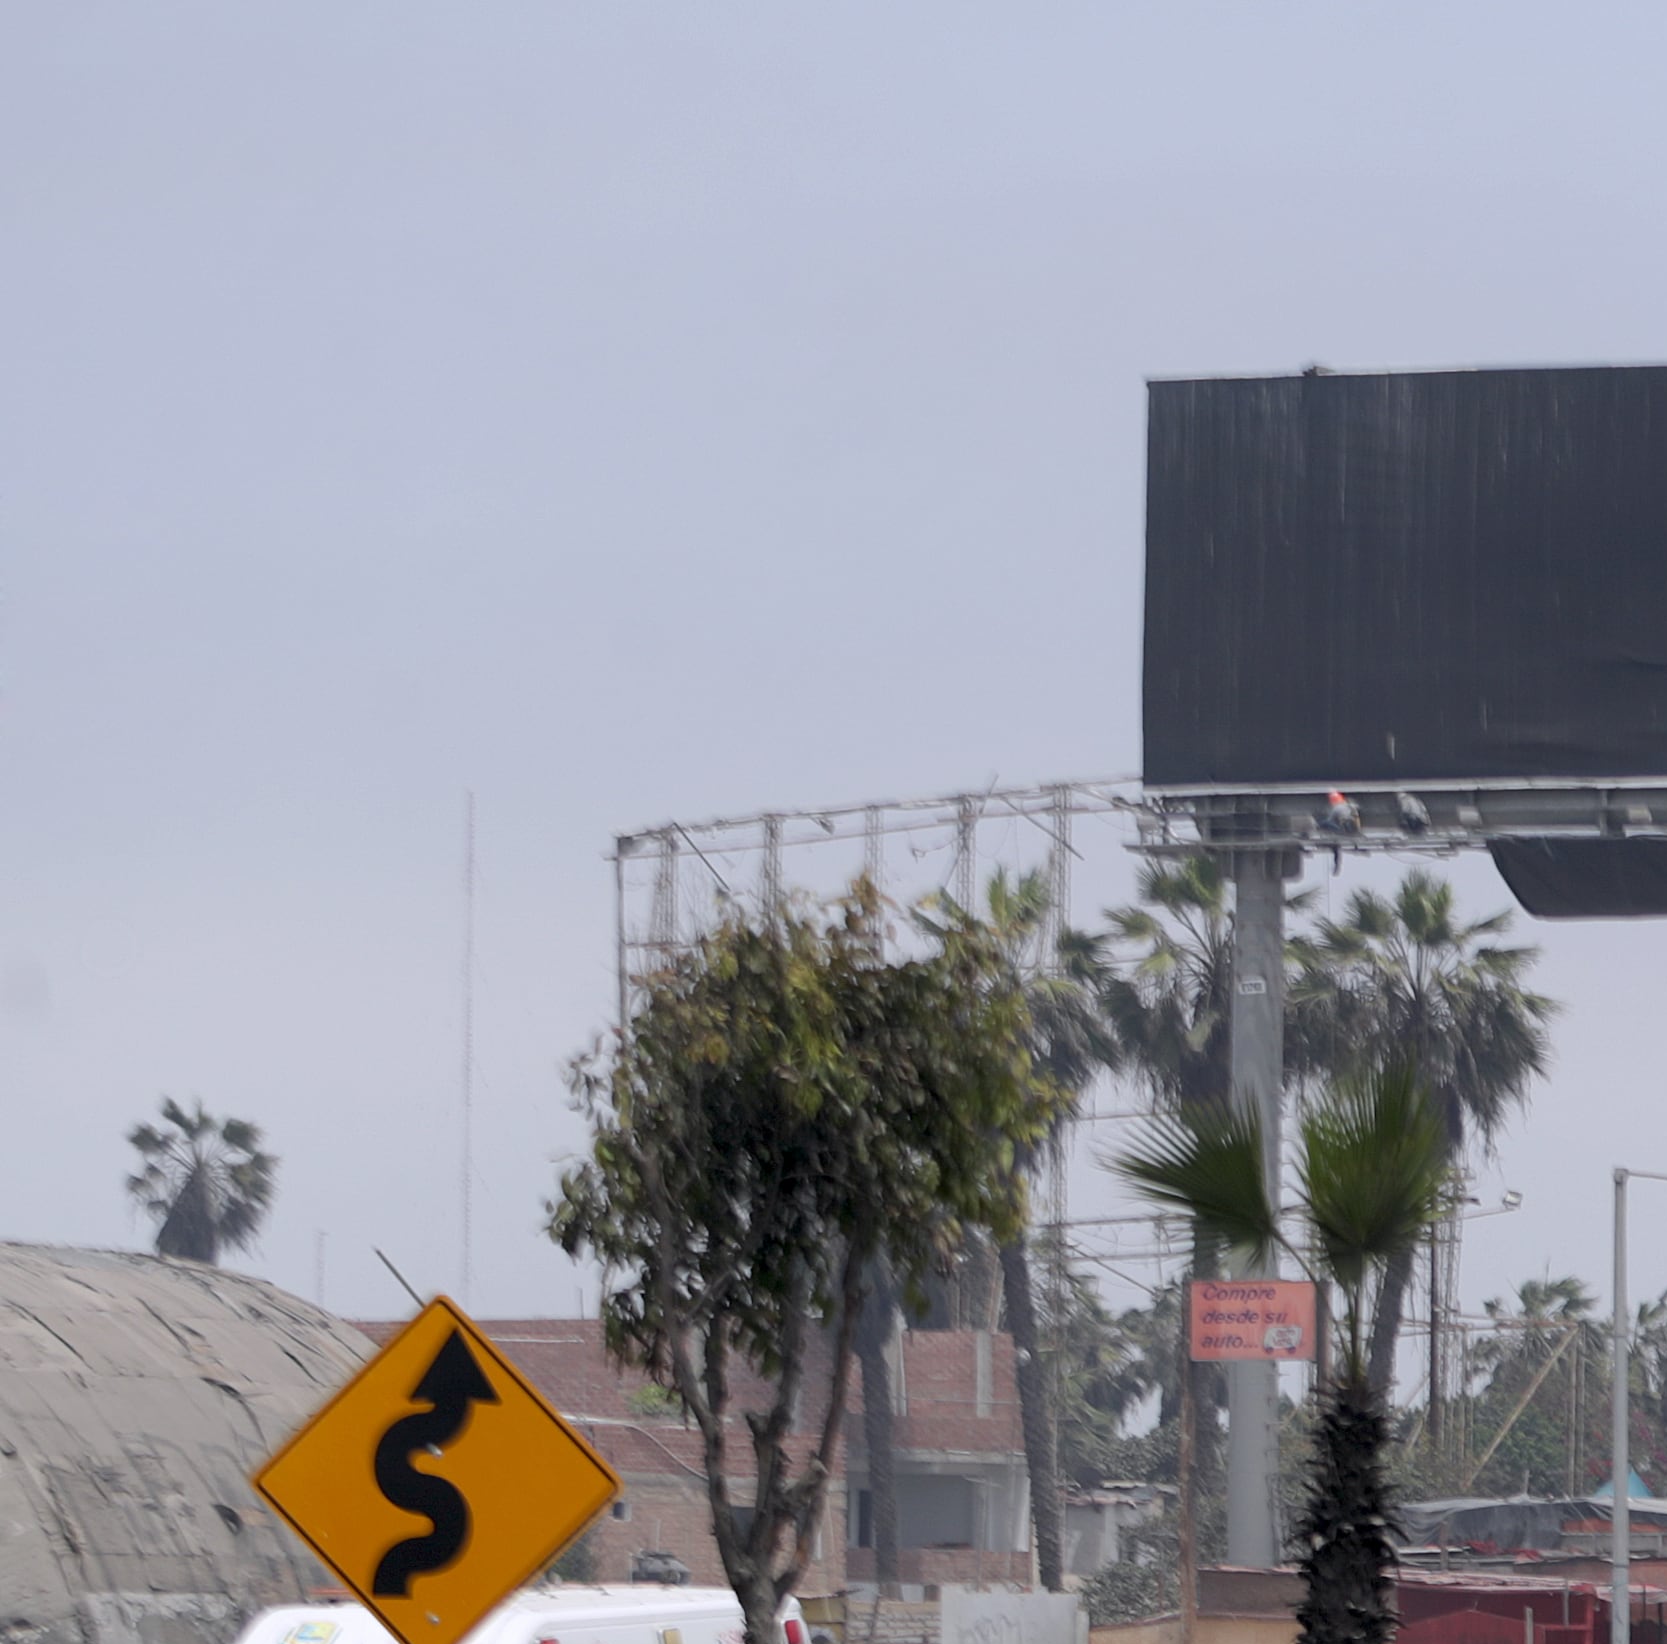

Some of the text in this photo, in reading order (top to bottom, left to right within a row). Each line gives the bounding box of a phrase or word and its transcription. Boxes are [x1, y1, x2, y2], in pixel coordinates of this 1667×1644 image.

[1202, 1284, 1276, 1304] Compre
[1202, 1310, 1288, 1324] desde su
